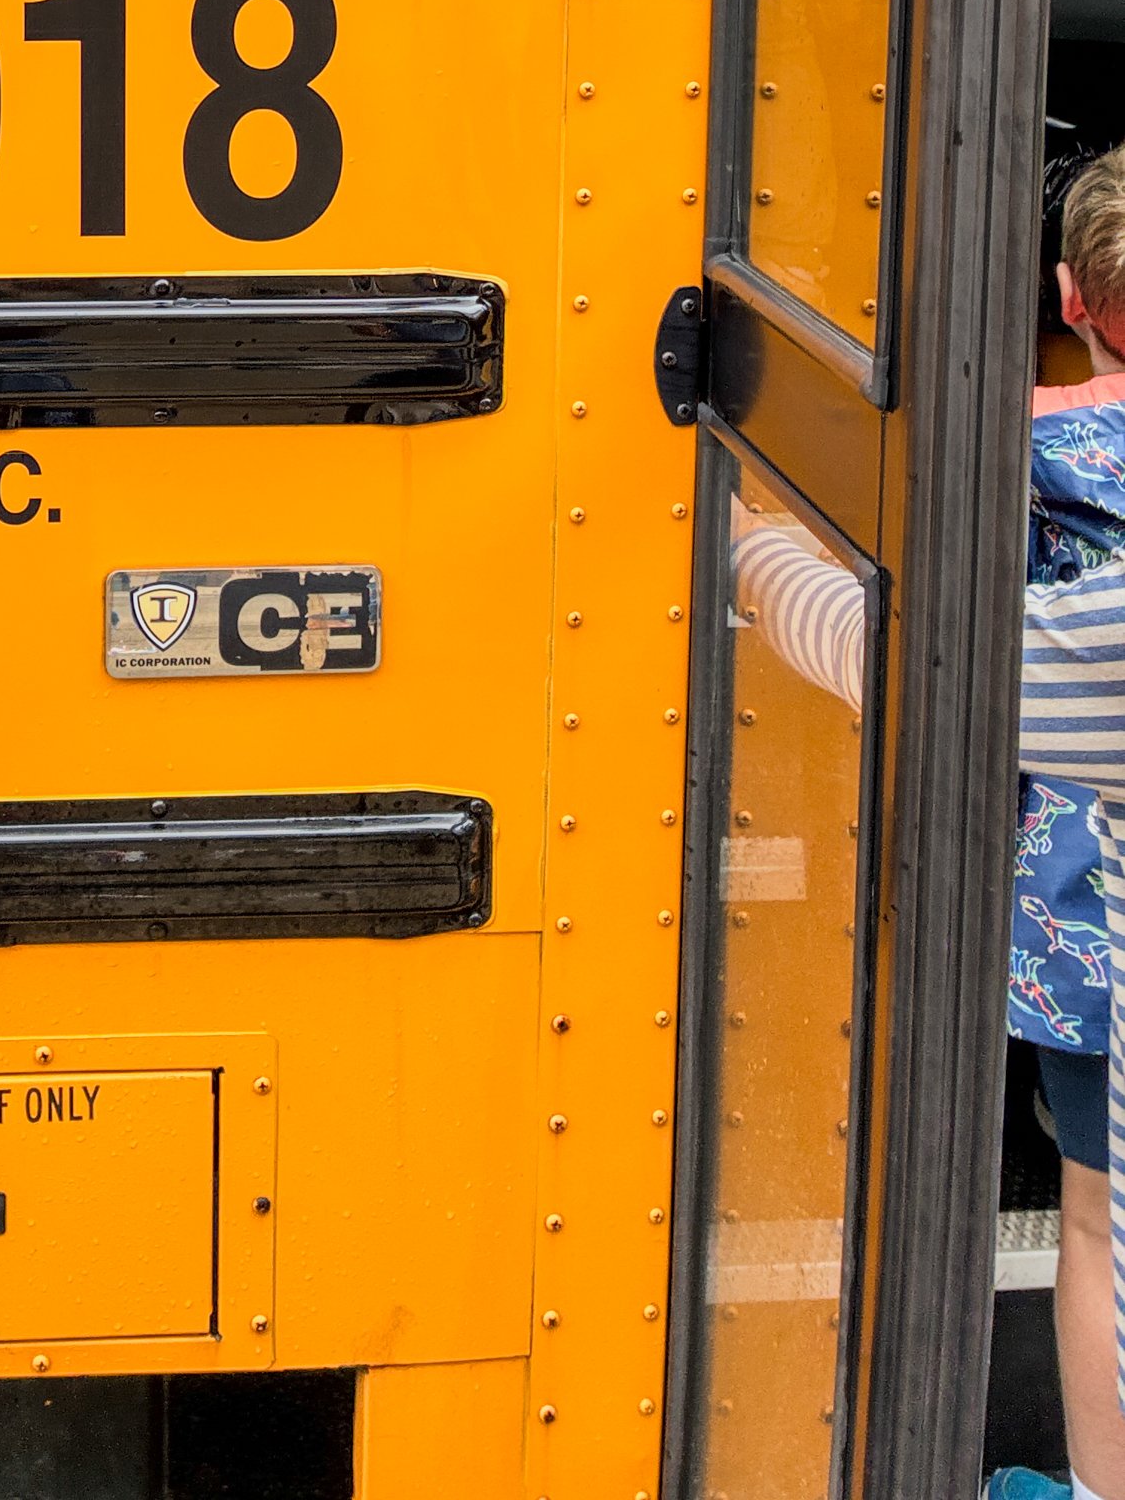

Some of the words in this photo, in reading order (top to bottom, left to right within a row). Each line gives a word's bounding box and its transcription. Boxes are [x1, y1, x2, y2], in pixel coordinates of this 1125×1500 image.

[236, 591, 364, 653] CE
[115, 657, 127, 668] IC
[129, 656, 212, 668] CORPORATION
[25, 1084, 100, 1123] ONLY
